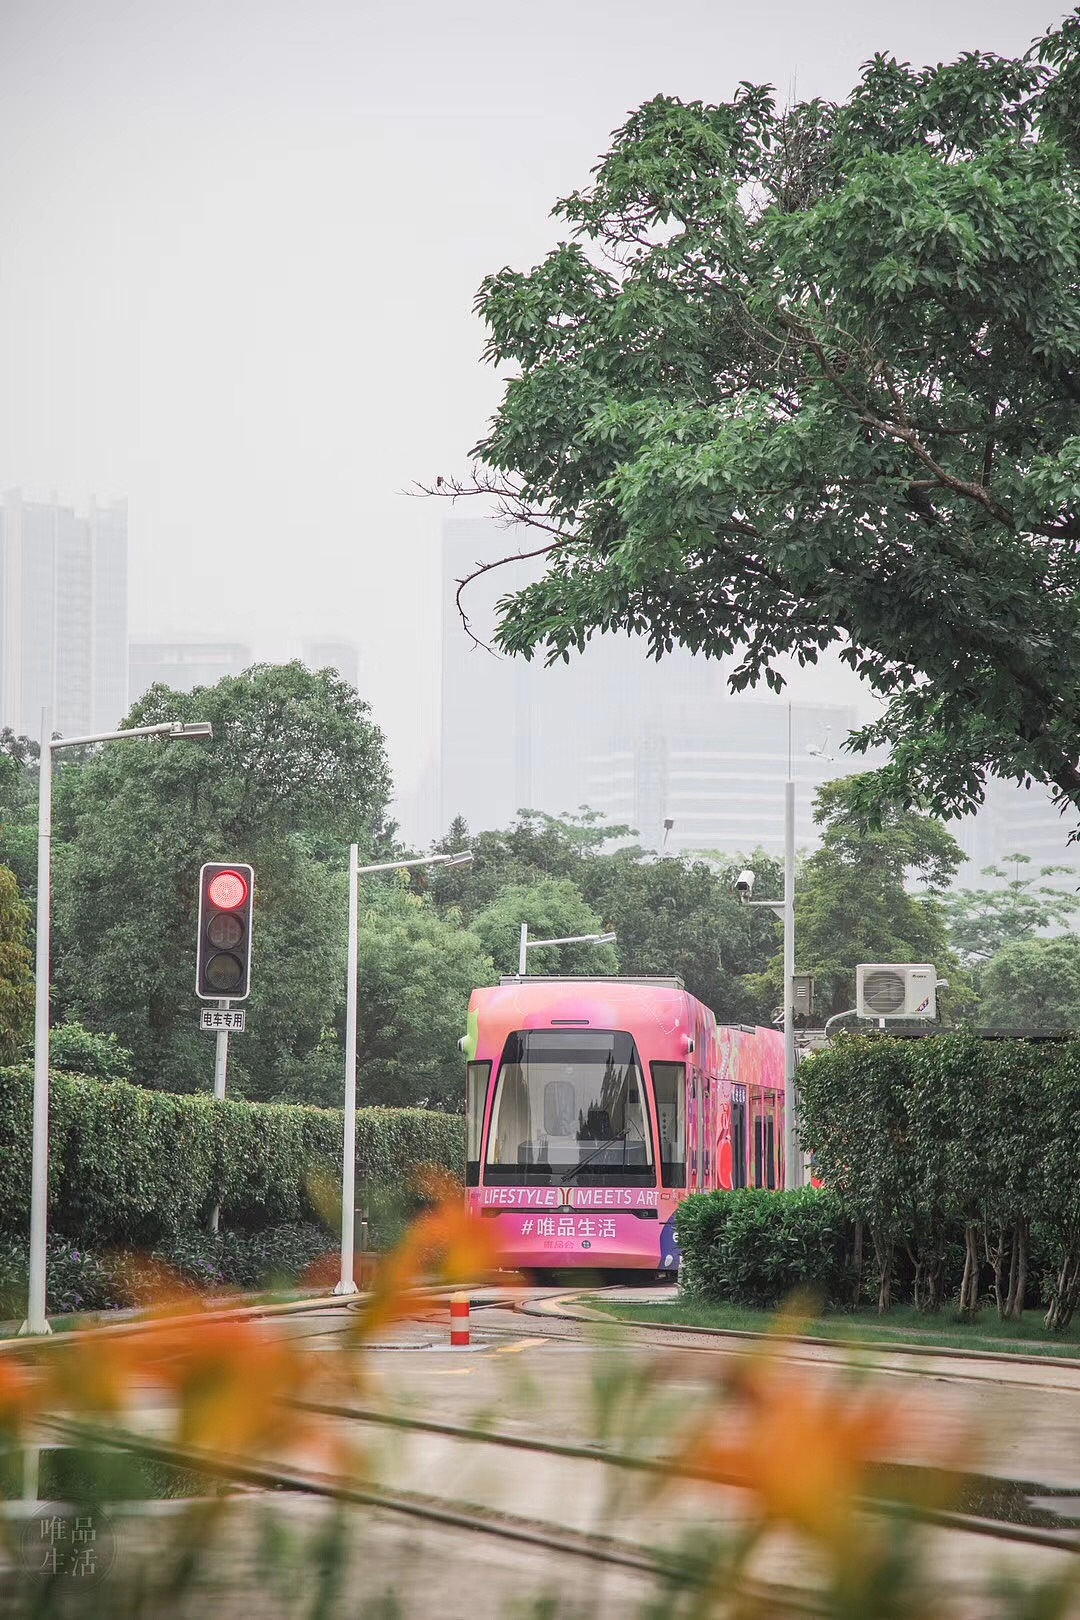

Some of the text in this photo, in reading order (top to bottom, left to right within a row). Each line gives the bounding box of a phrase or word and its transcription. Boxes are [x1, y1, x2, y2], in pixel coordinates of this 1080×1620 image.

[203, 1012, 243, 1027] 电车专用
[484, 1188, 660, 1206] LIFESTYLE MEETS ART
[521, 1217, 616, 1238] #唯品生活
